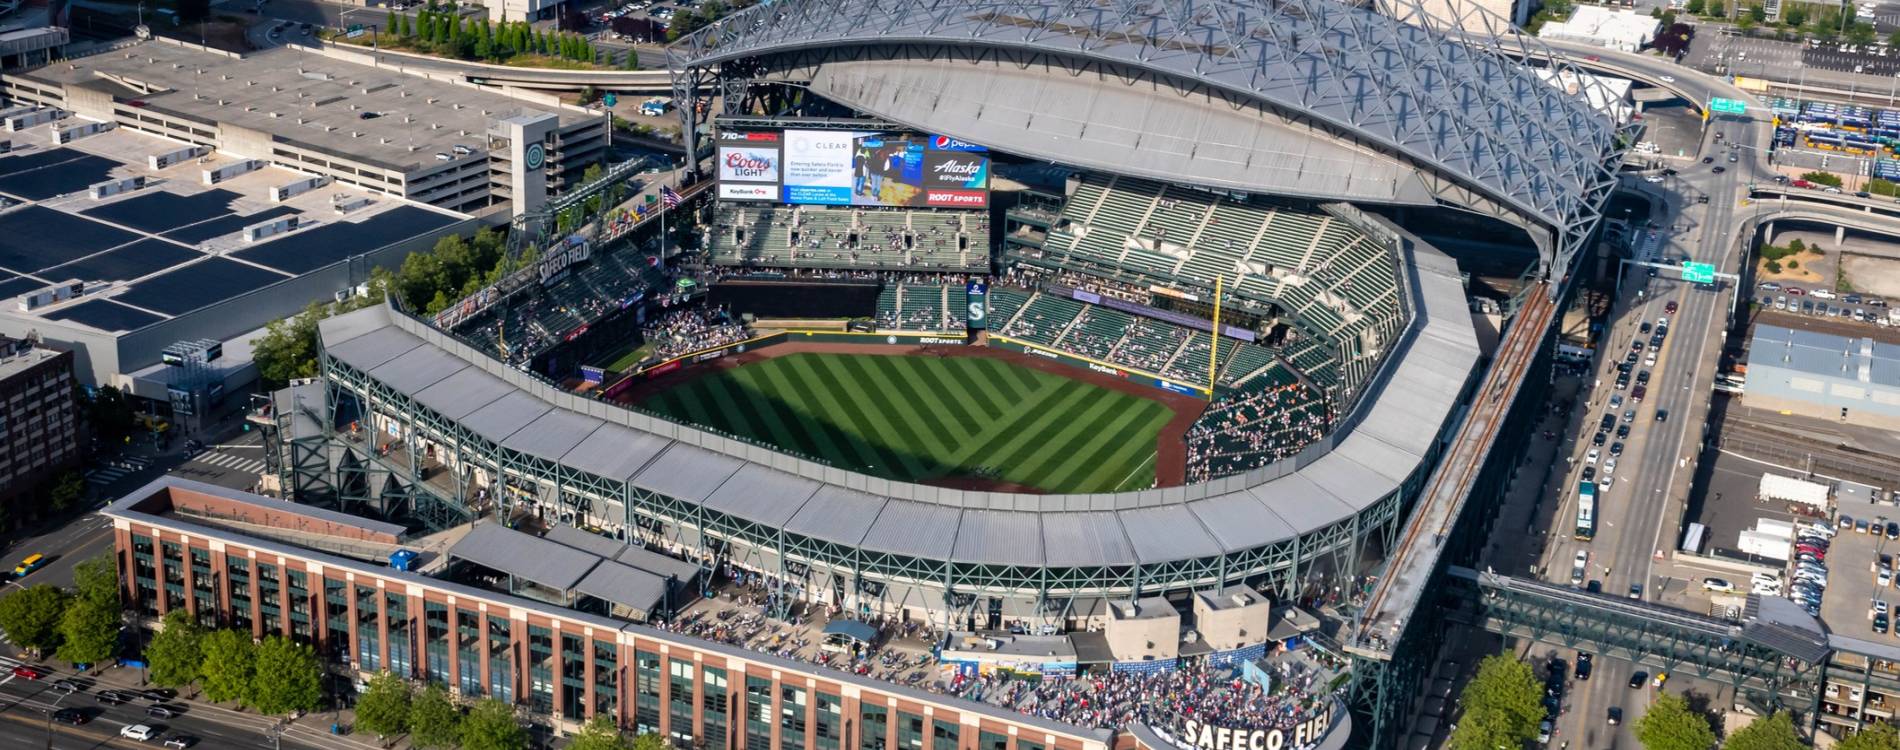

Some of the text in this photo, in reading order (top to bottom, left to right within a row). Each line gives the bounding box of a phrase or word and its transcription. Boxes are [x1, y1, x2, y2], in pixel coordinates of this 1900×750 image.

[721, 132, 738, 140] 710
[815, 142, 848, 150] CLEAR
[726, 152, 771, 170] Coors
[934, 160, 980, 174] Alaska
[735, 168, 763, 177] LIGHT
[928, 193, 983, 203] ROOT SPORTS
[539, 252, 567, 284] SAFECO
[568, 241, 590, 265] FIELD
[1089, 362, 1118, 375] KeyBank
[1184, 719, 1284, 750] SAFECO
